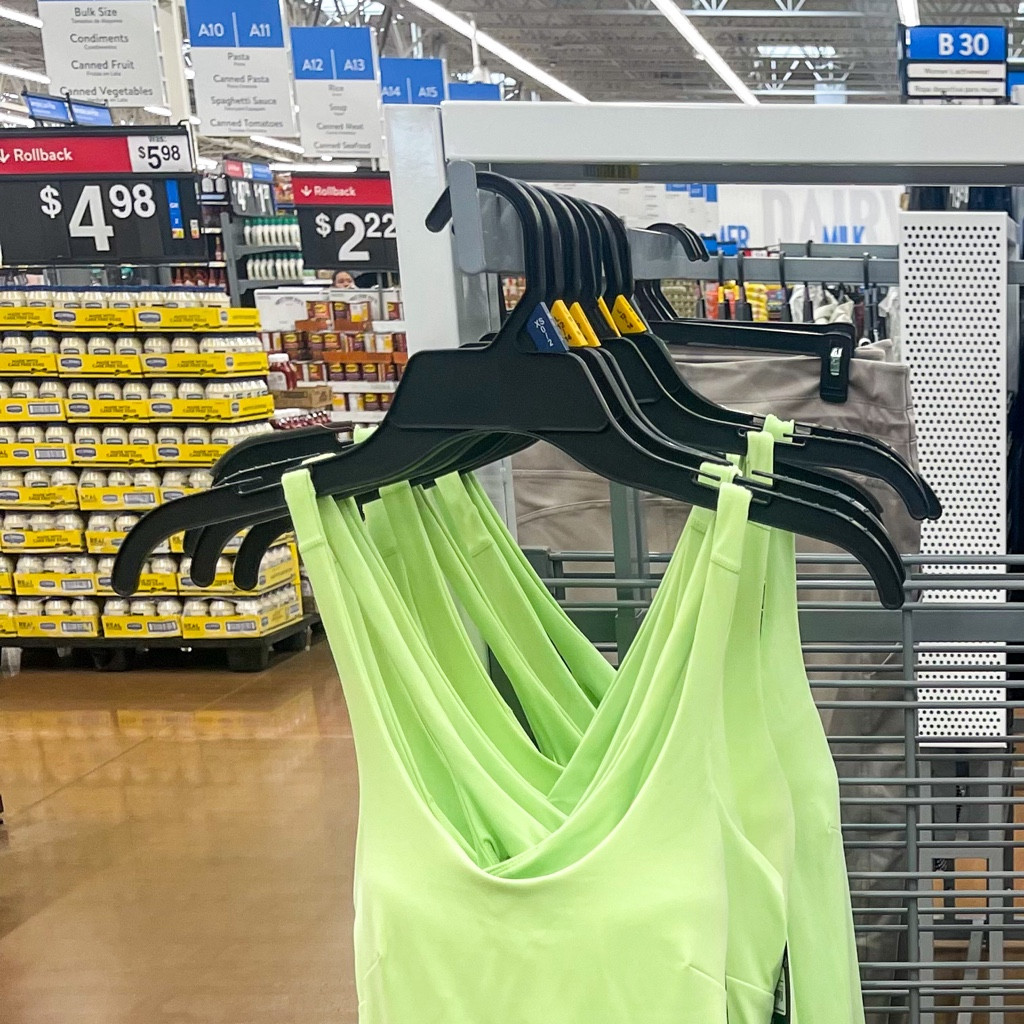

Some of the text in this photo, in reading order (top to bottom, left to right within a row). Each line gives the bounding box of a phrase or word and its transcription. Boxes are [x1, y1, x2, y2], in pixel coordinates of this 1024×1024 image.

[74, 7, 117, 17] Bulk Size
[198, 23, 271, 37] A10 A11
[69, 34, 129, 43] Condiments
[938, 33, 989, 56] B 30
[227, 52, 250, 61] Pasta
[71, 60, 135, 69] Canned Fruit
[302, 59, 366, 71] A12 A13
[60, 87, 153, 98] Canned Vegetables
[381, 86, 438, 97] A14 A15
[13, 148, 73, 162] Rollback
[314, 185, 356, 197] Rollback
